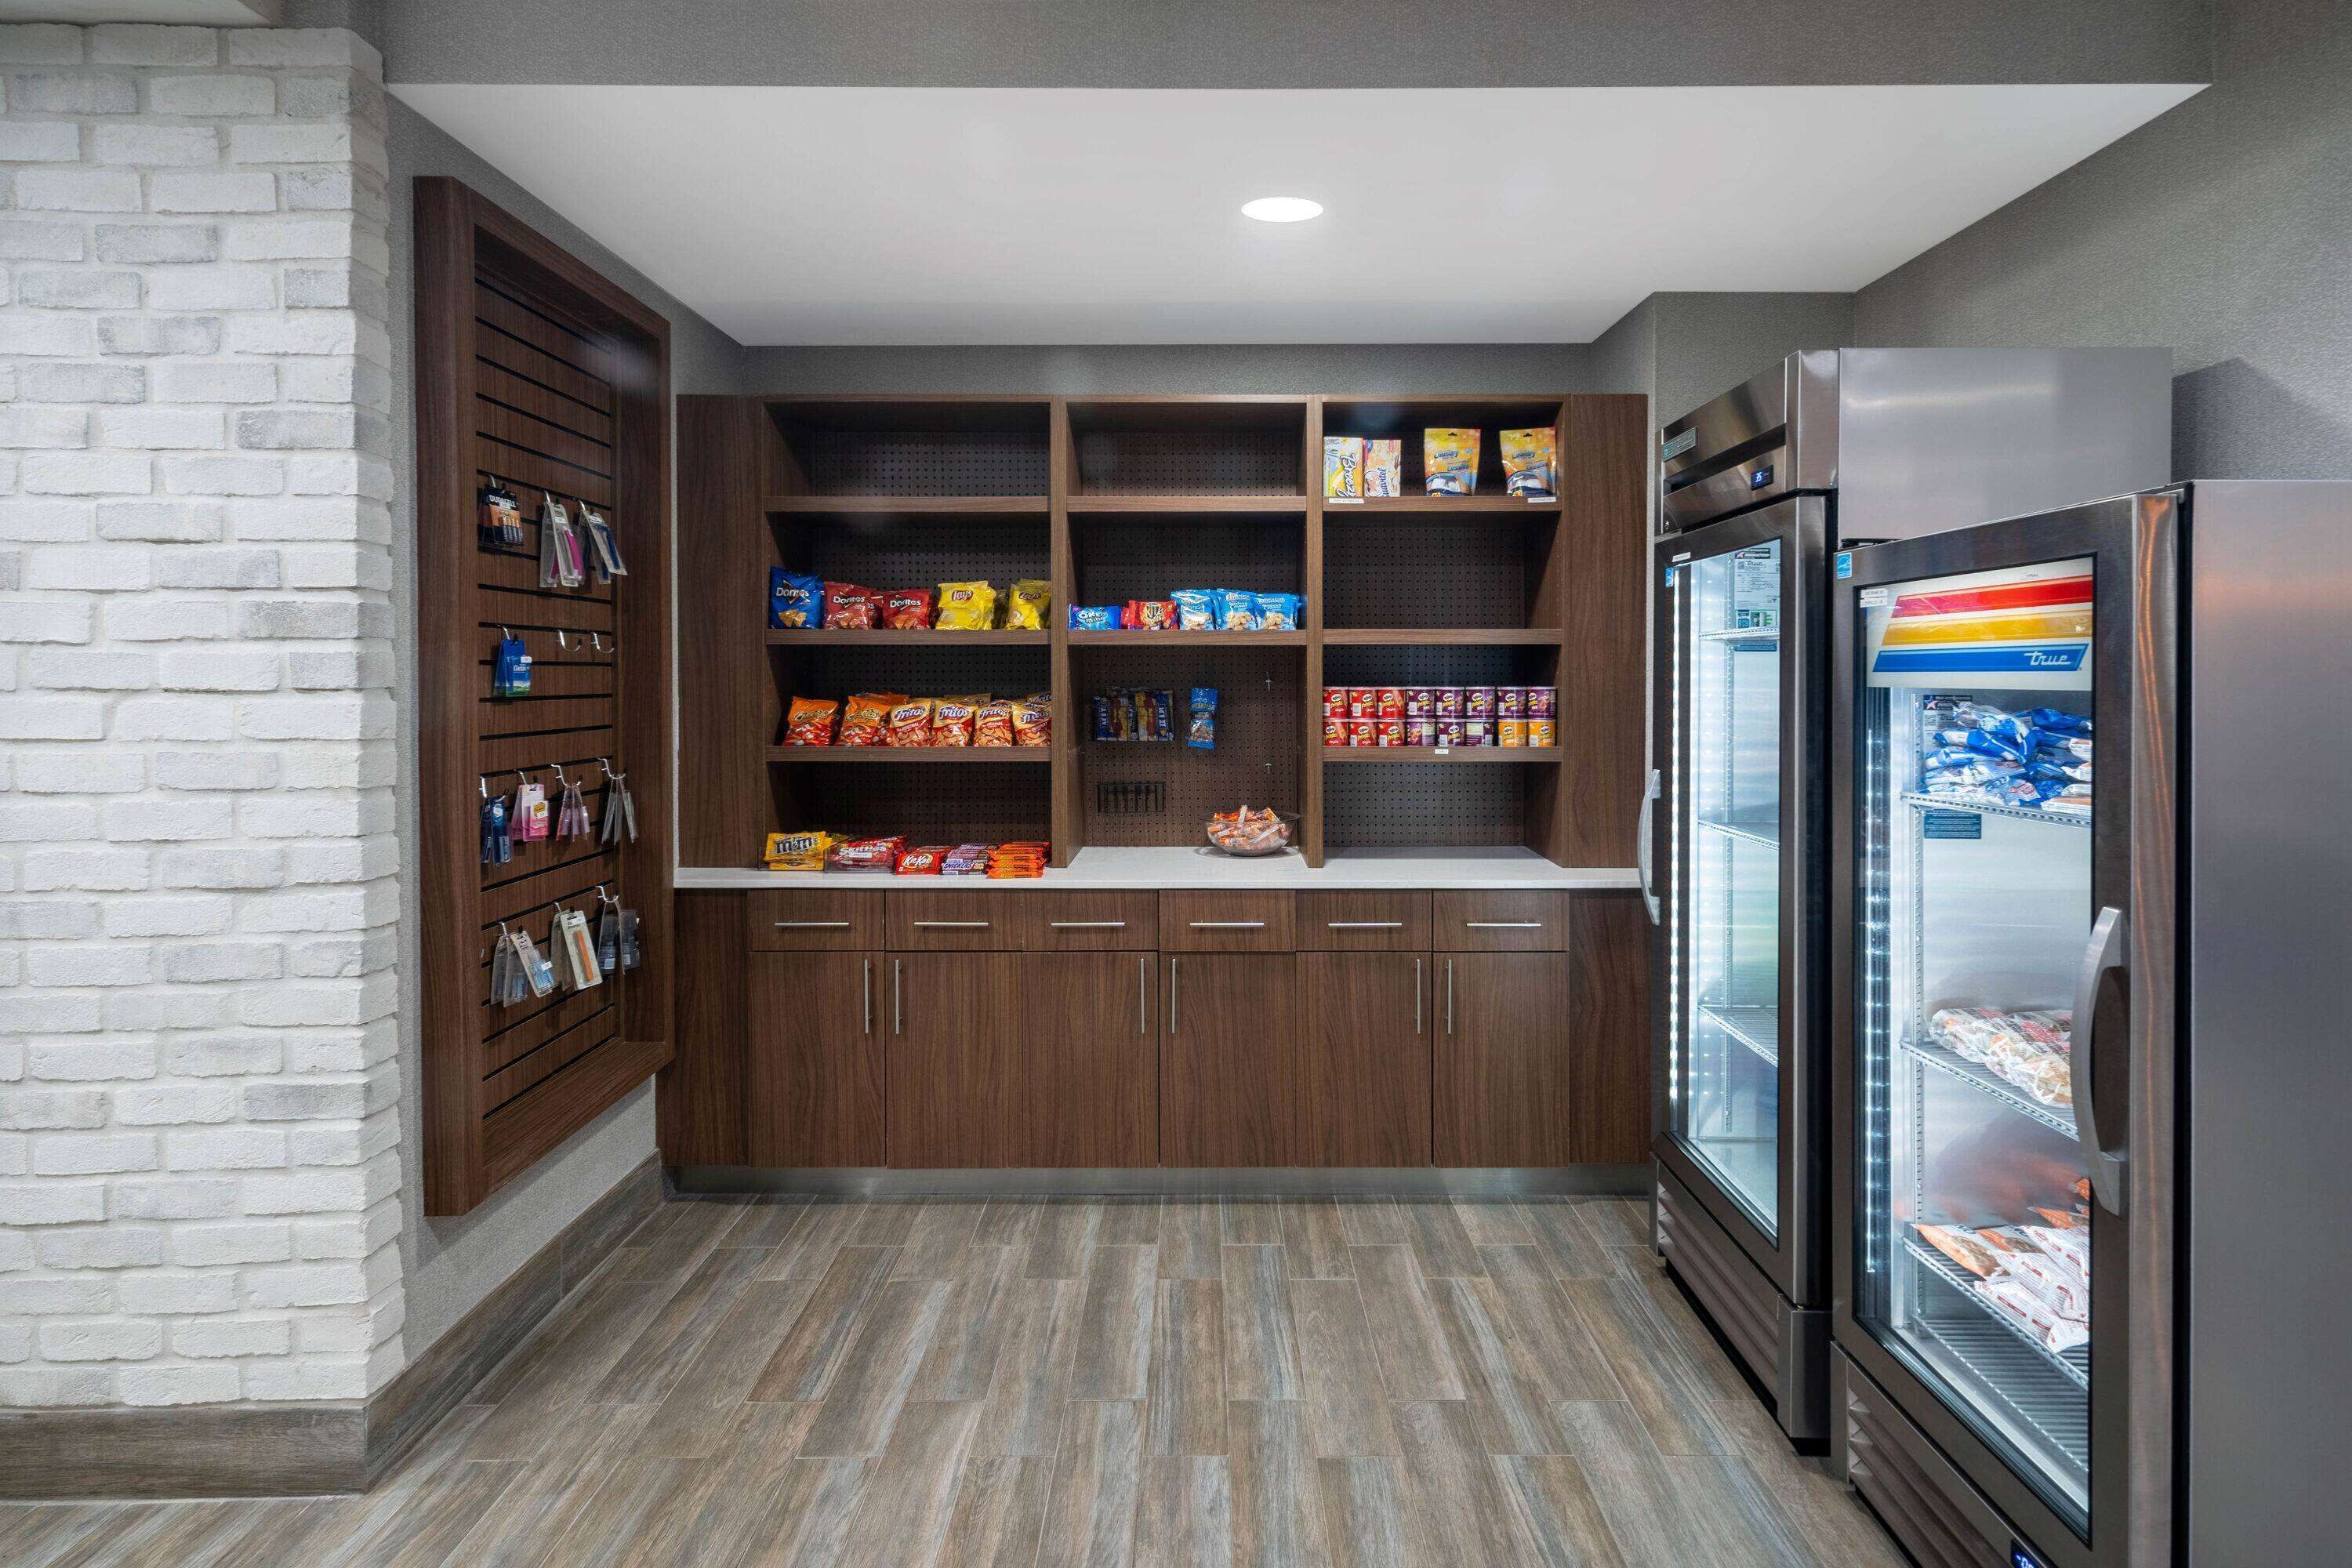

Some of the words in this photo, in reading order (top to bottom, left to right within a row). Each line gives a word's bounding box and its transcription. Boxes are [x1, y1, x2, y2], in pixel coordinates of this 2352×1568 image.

[1336, 452, 1357, 496] Breezy
[1377, 466, 1390, 497] uavitel
[776, 587, 809, 597] Doritos
[833, 595, 866, 604] Doritos
[890, 599, 921, 608] Doritos
[894, 707, 925, 720] Fritos
[939, 706, 970, 719] Fritos
